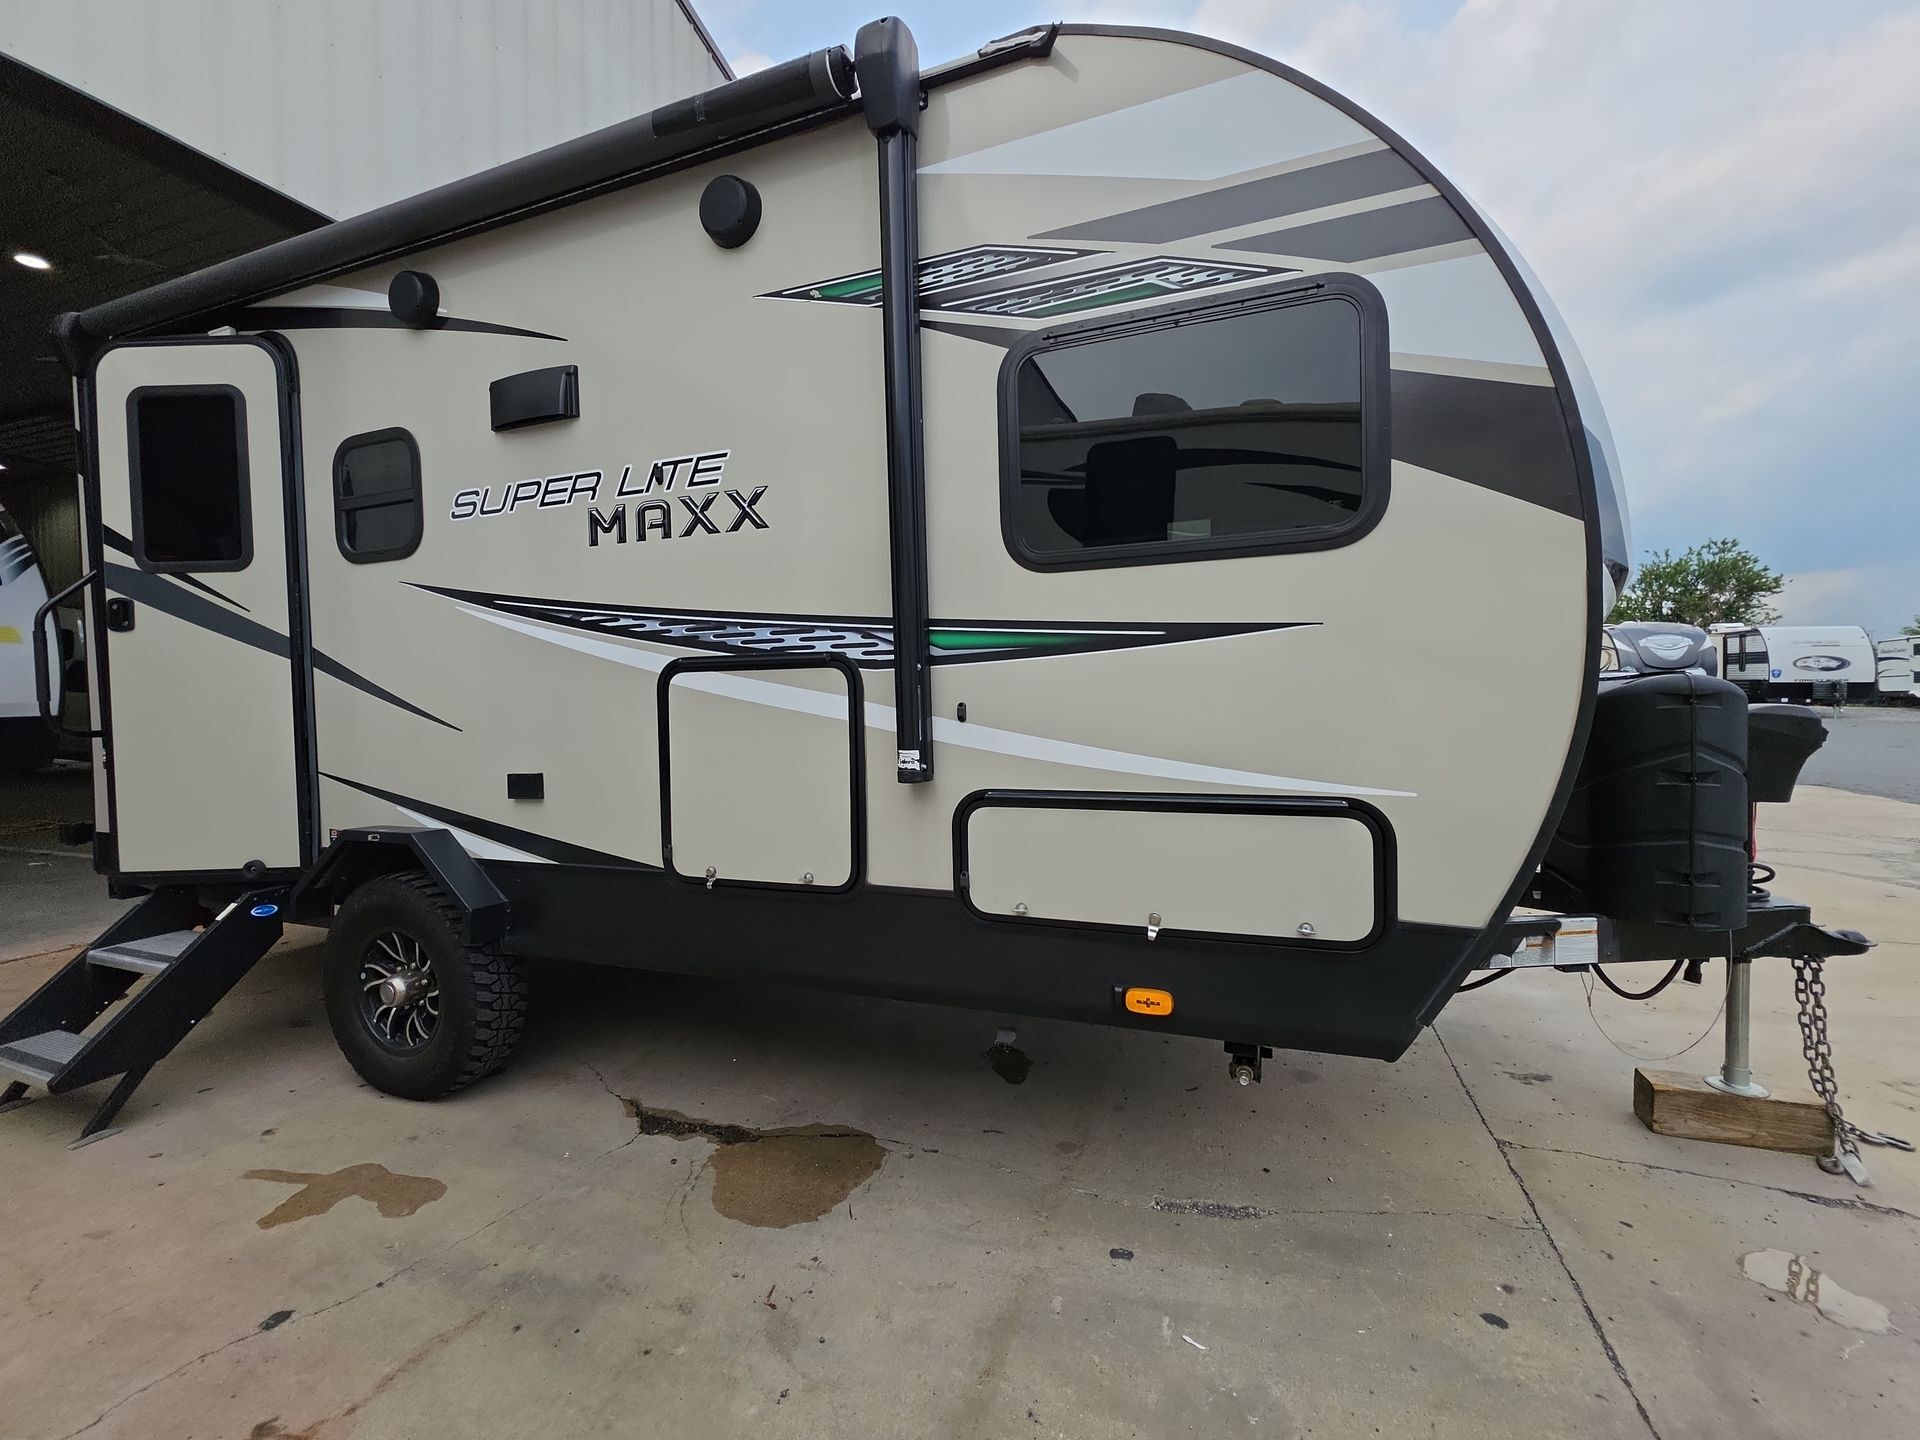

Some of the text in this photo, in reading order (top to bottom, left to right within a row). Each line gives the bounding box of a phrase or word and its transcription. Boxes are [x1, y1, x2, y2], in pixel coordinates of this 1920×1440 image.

[450, 450, 731, 520] SUPER LITE
[587, 486, 769, 547] MAXX
